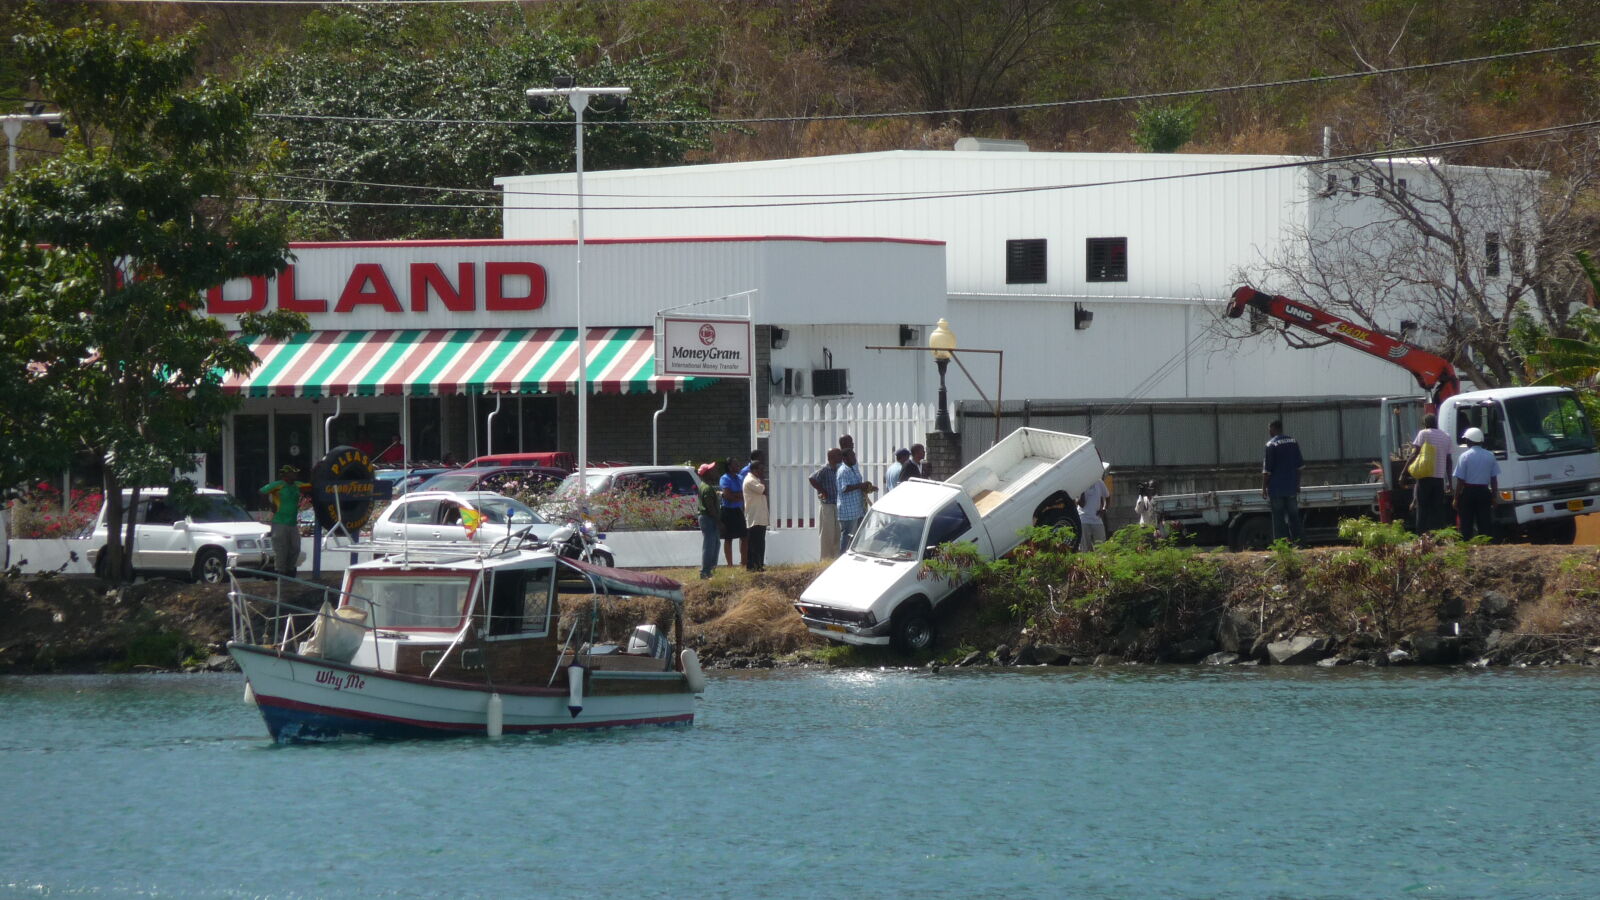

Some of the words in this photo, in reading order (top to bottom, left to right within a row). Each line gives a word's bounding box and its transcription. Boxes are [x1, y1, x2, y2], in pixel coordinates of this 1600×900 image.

[1285, 304, 1313, 321] UNIC
[672, 346, 741, 361] MoneyGram
[315, 670, 343, 691] Why
[344, 673, 366, 689] Me
